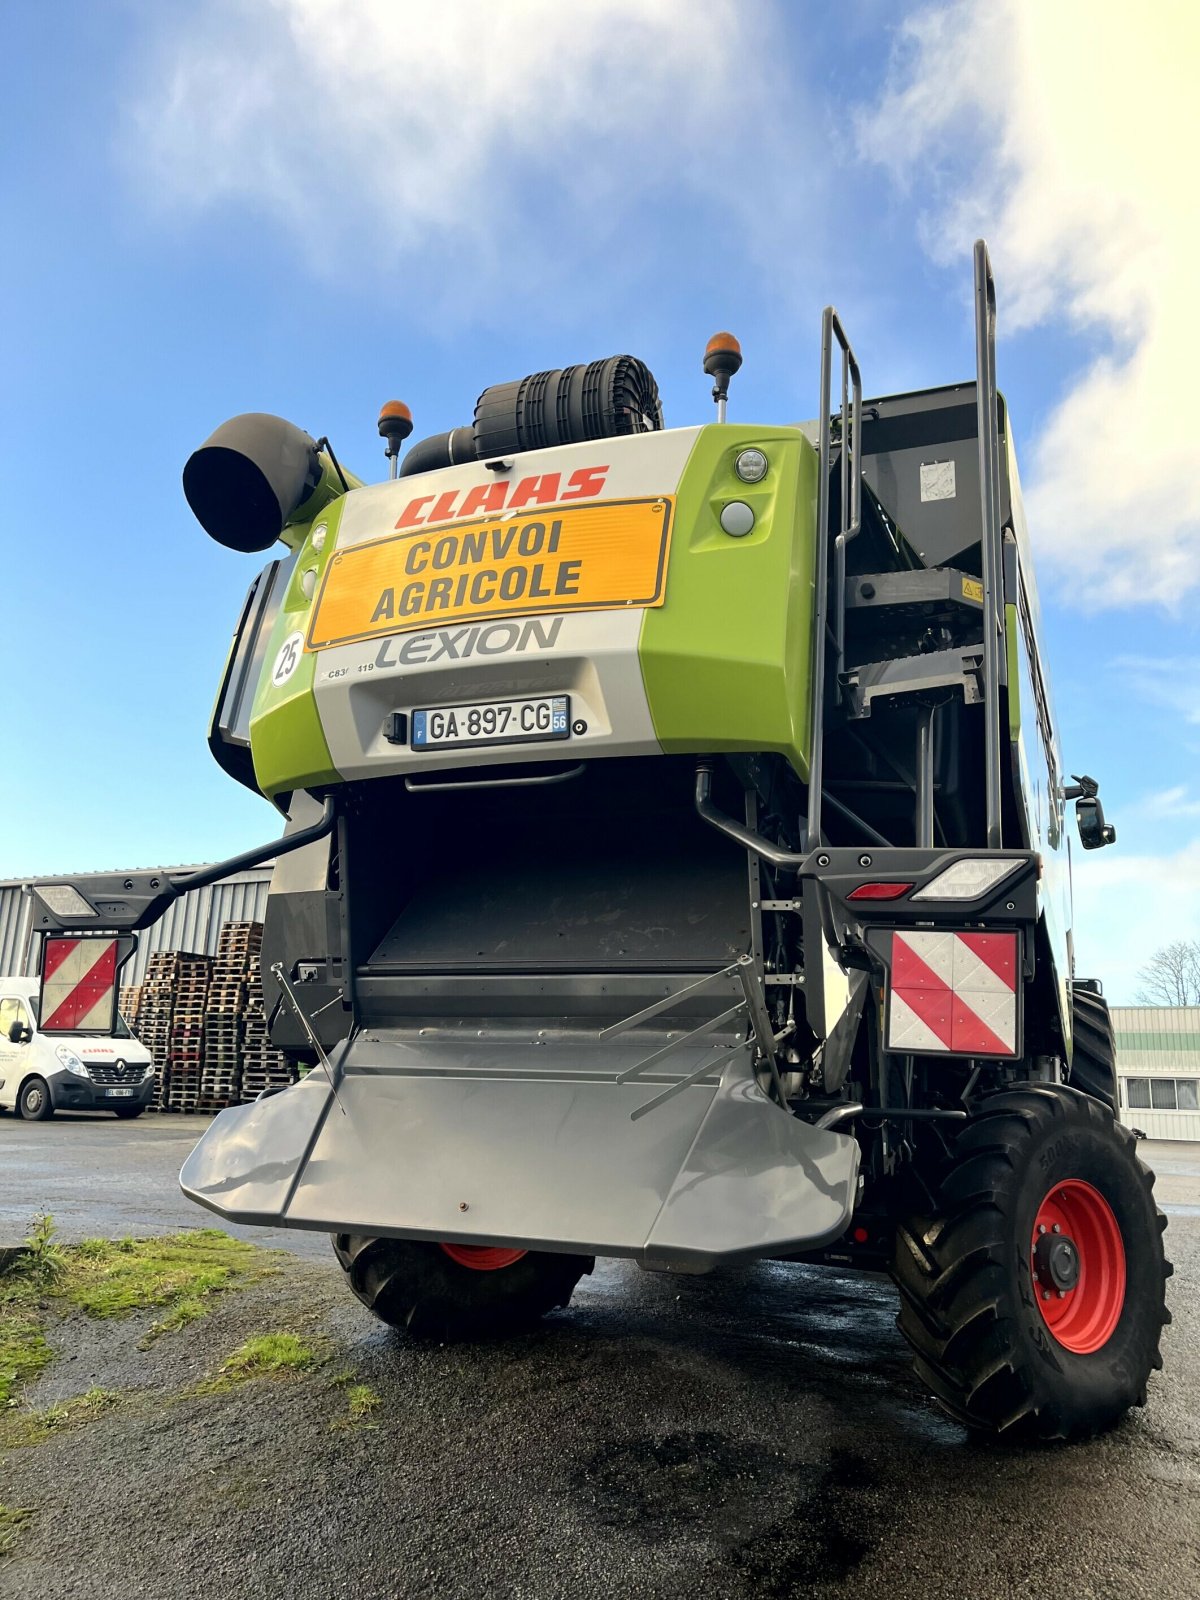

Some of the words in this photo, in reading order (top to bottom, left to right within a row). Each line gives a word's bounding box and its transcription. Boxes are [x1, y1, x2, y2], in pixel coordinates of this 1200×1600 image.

[394, 465, 610, 530] CLAAS
[404, 520, 563, 576] CONVOI
[370, 560, 583, 623] AGRICOLE
[275, 638, 300, 680] 25
[374, 617, 564, 669] LEXION
[430, 702, 551, 739] GA-897-CG
[553, 715, 566, 729] 56
